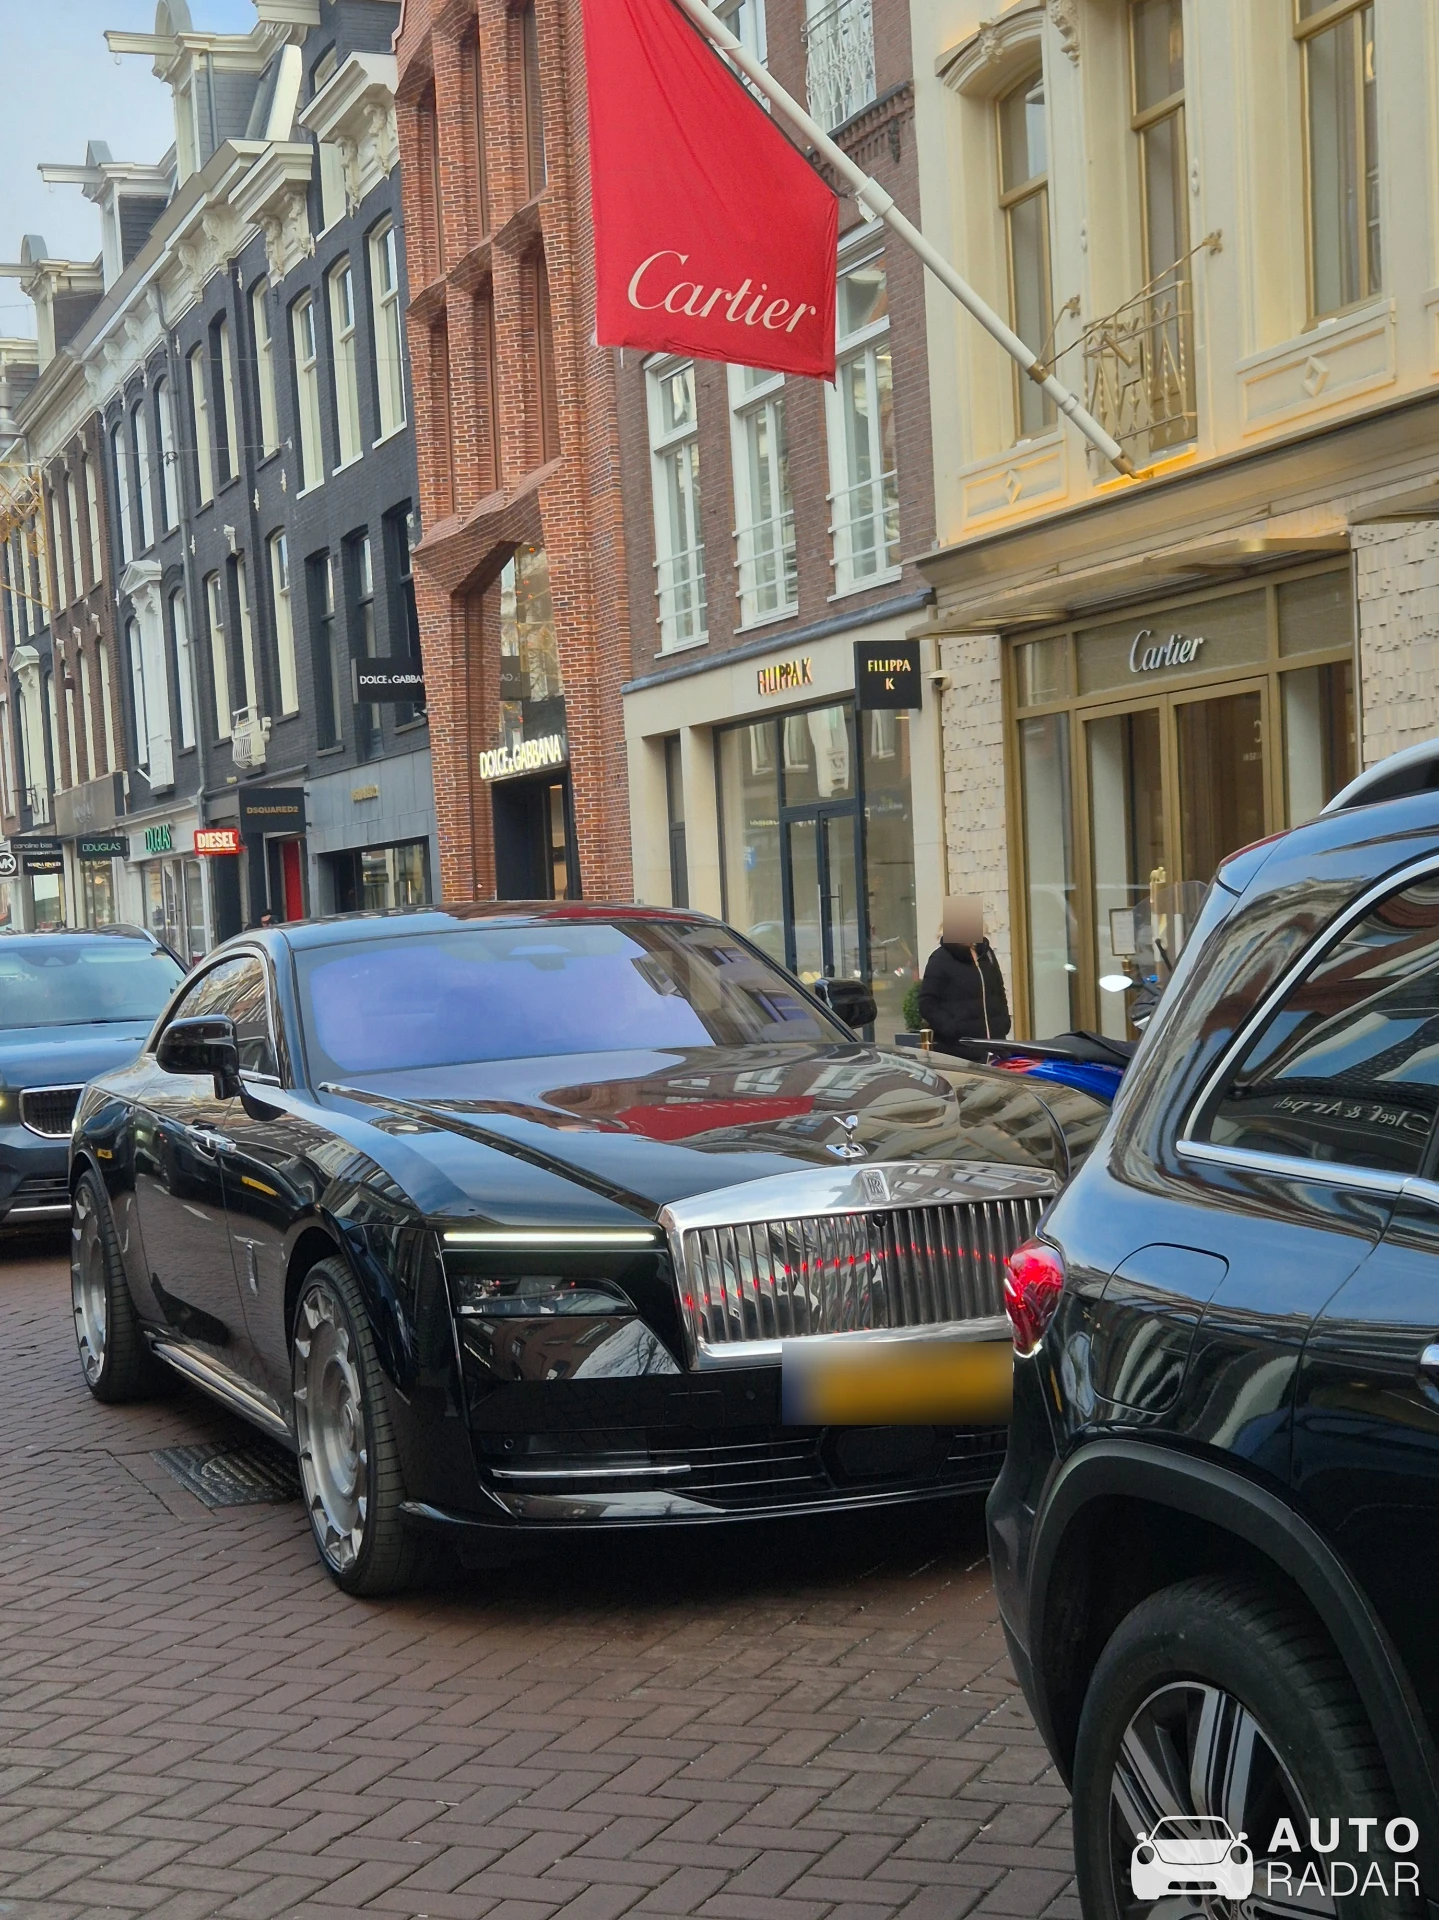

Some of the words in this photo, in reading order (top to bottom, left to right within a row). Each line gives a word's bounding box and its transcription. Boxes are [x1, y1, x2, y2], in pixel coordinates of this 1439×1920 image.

[628, 250, 816, 332] Cartier
[1129, 629, 1204, 673] Cartier
[867, 659, 911, 672] FILIPPA
[757, 660, 801, 695] FILIPPA
[802, 657, 813, 685] K
[885, 678, 895, 690] K
[246, 806, 299, 814] DSQUARED2
[145, 824, 172, 853] DOUGLAS
[197, 832, 237, 848] DIESEL
[82, 843, 121, 851] DOUGLAS
